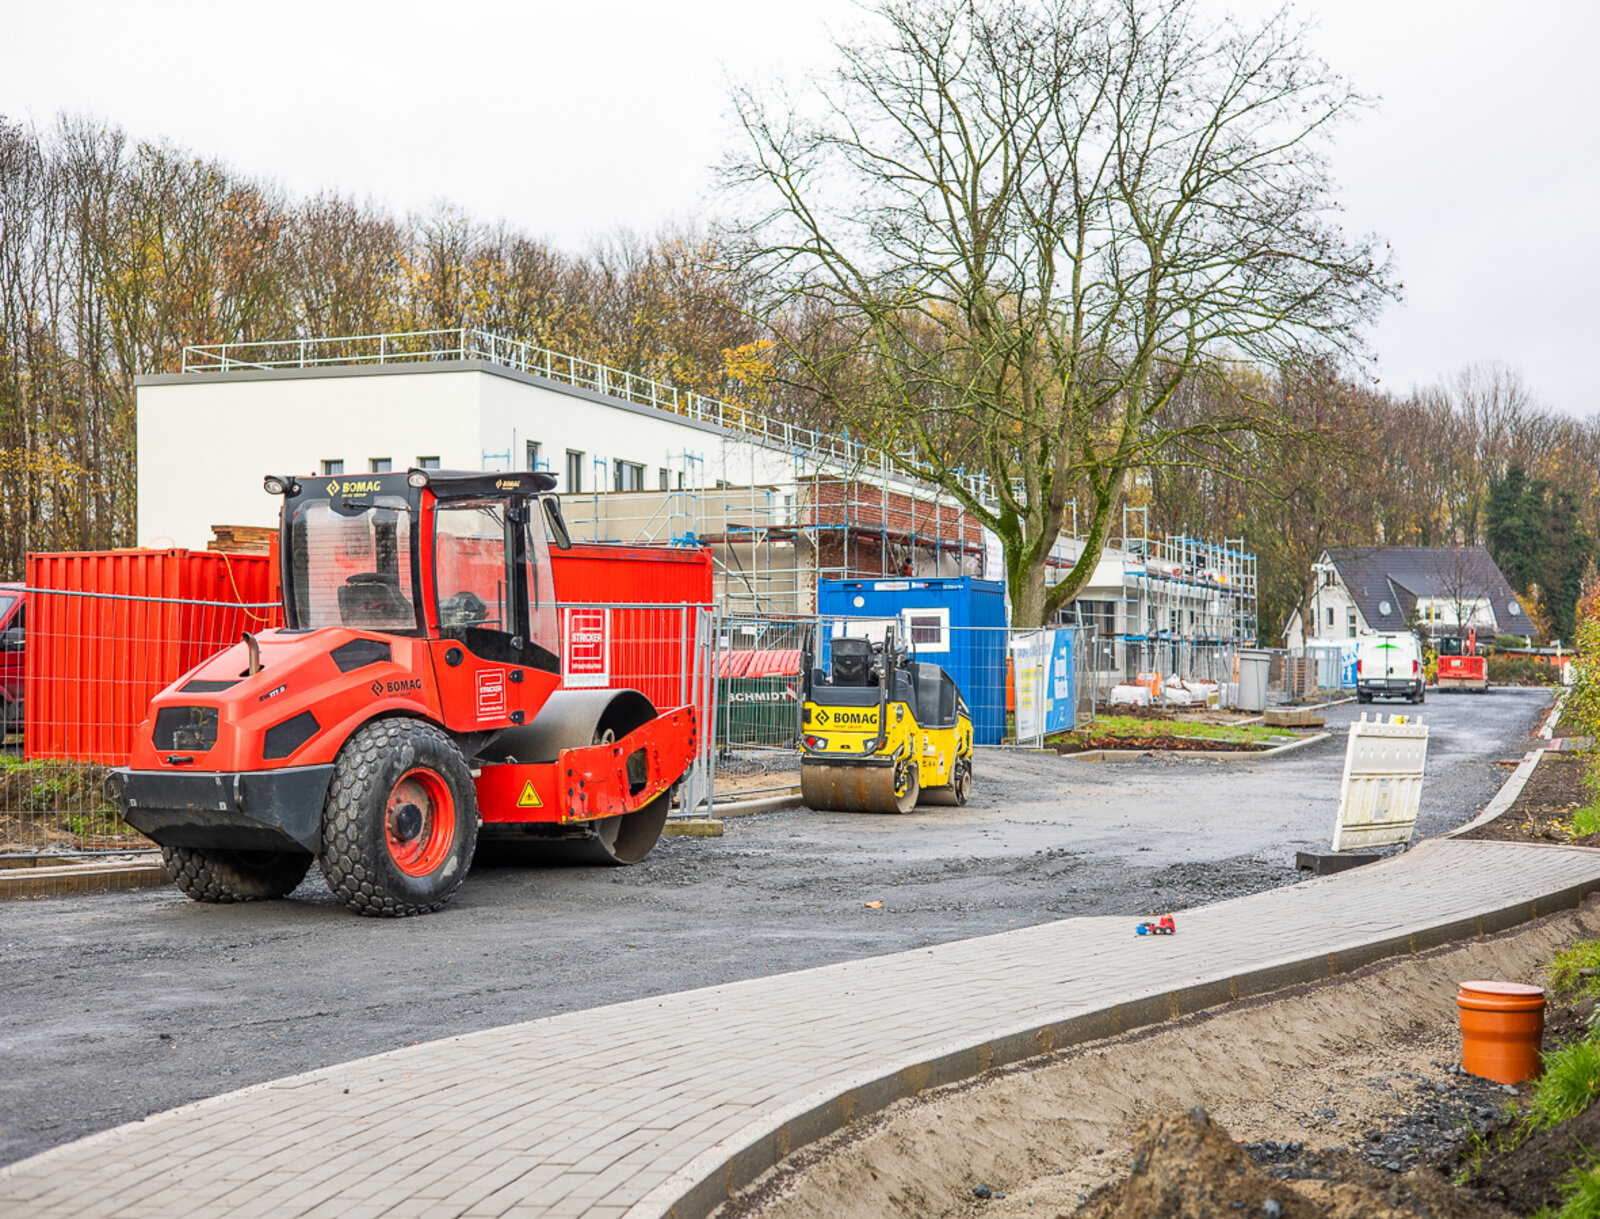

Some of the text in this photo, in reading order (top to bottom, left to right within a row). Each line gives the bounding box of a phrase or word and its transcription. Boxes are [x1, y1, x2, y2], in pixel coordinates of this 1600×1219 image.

[342, 480, 381, 493] BOMAG
[571, 633, 602, 642] STRICKER
[386, 678, 422, 693] BOMAG
[834, 713, 878, 724] BOMAG
